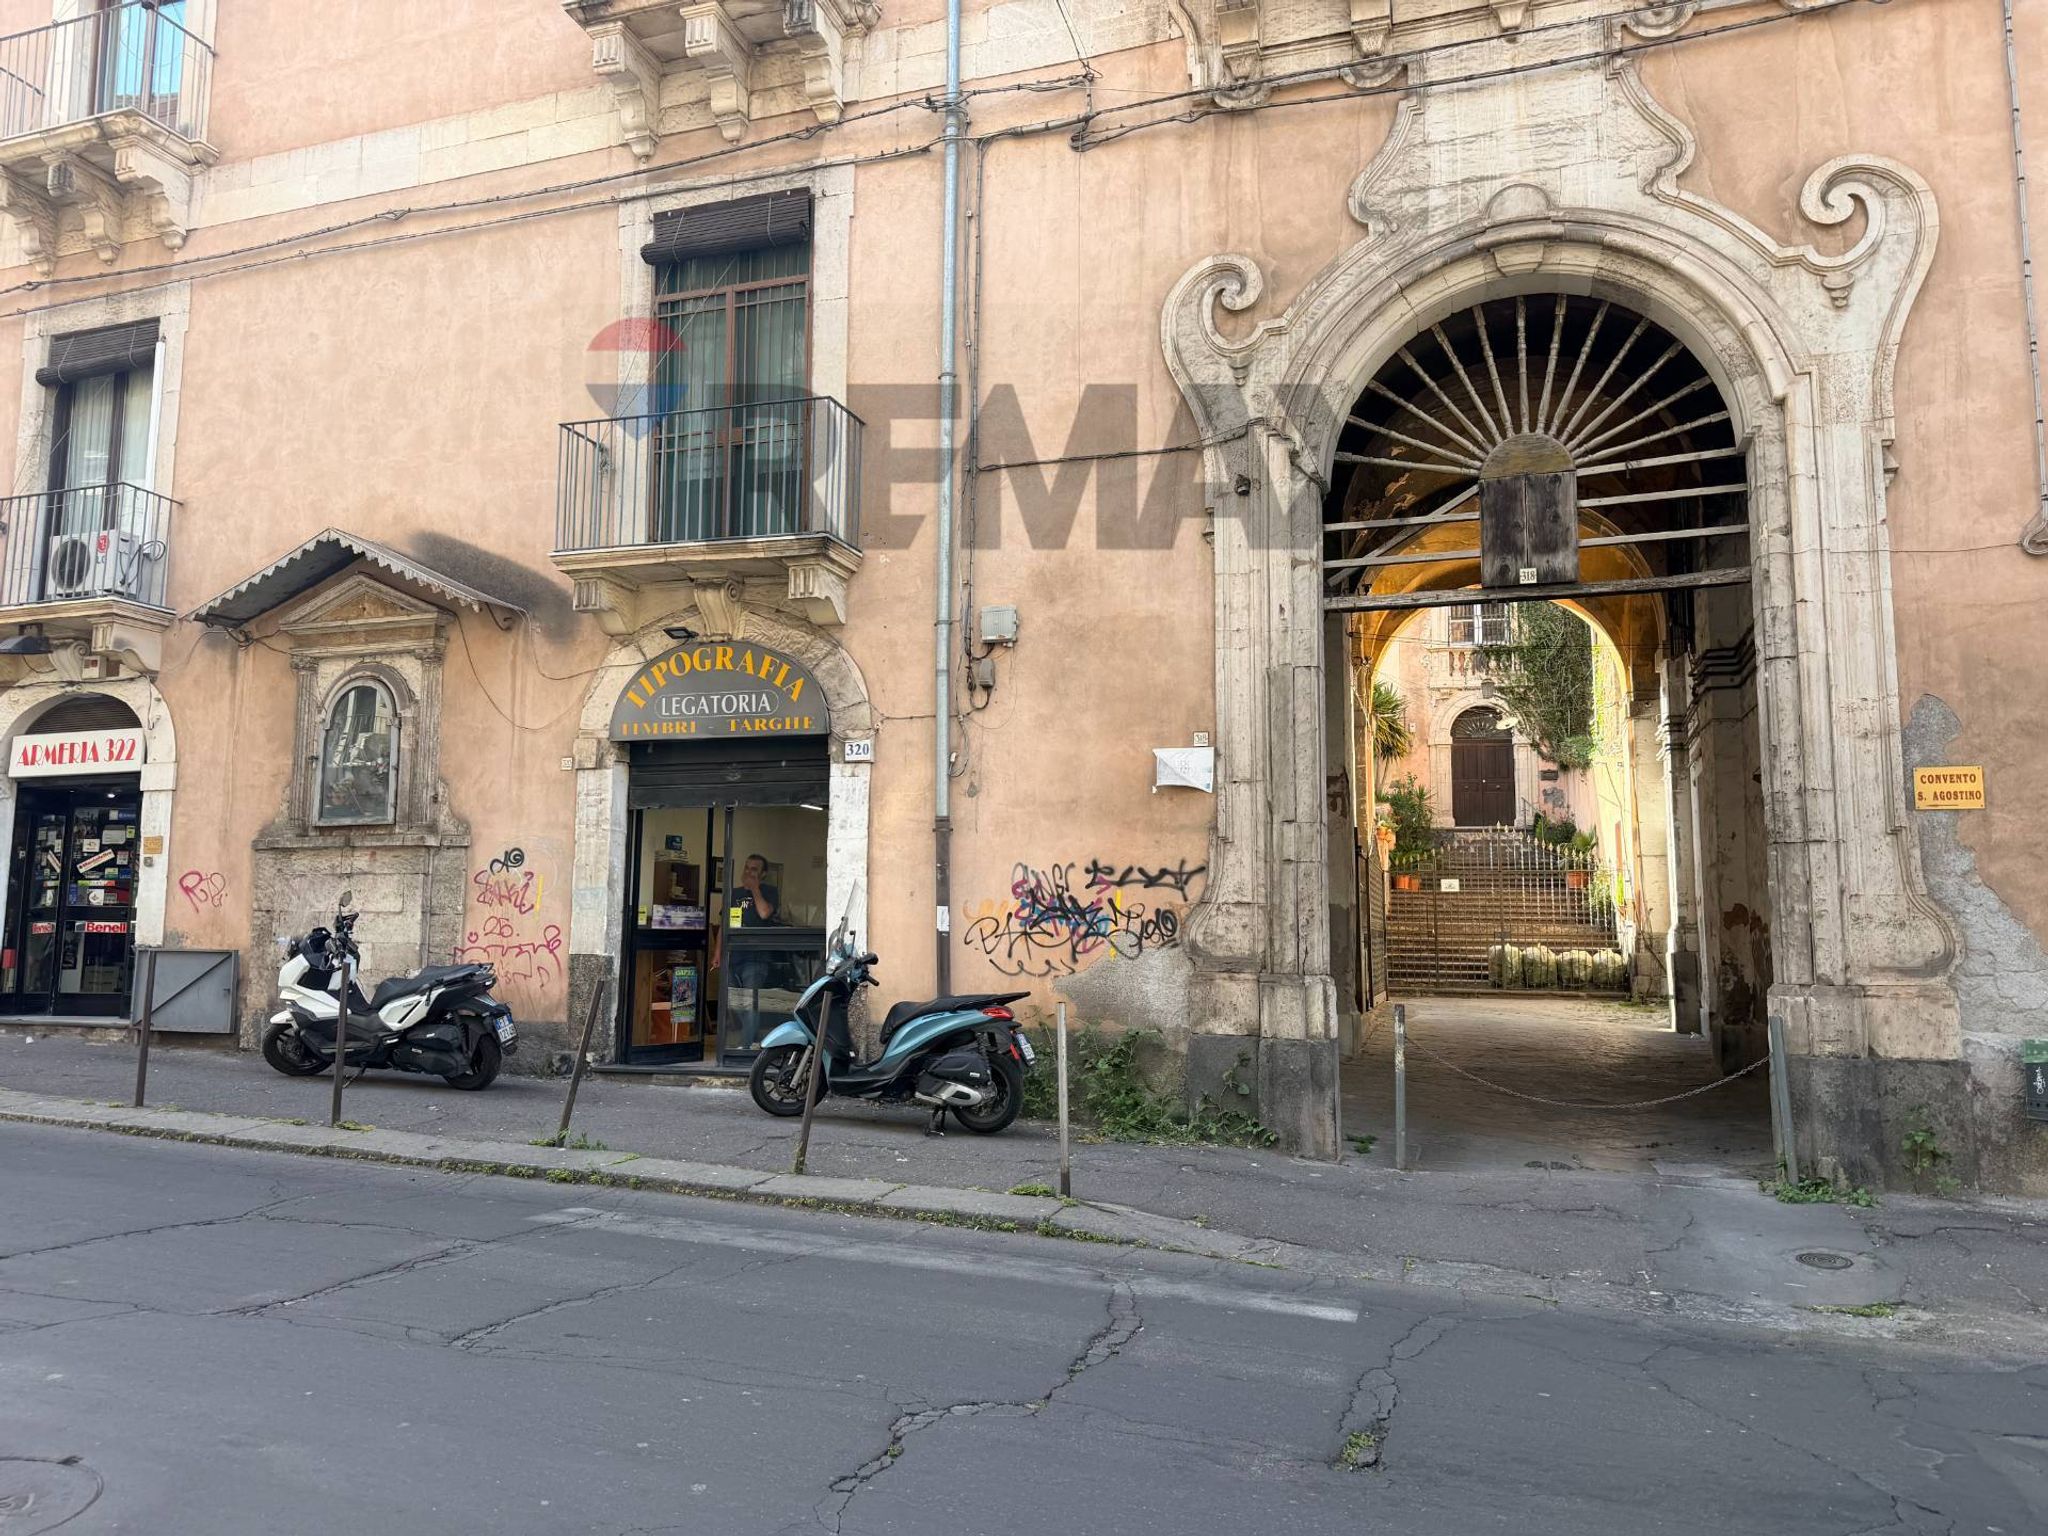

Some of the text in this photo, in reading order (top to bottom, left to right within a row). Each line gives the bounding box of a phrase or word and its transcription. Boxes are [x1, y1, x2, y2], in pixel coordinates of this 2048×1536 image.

[1520, 571, 1535, 581] 318
[625, 646, 806, 709] TIPOGRAFIA
[661, 693, 771, 717] LEGATORIA
[621, 716, 815, 736] TIMBRI TARGHE
[17, 738, 136, 767] ARMERIA 322
[846, 743, 870, 756] 320
[1920, 773, 1976, 784] CONVENTO
[1917, 790, 1982, 801] S. AGOSTINO
[87, 922, 128, 933] Benell
